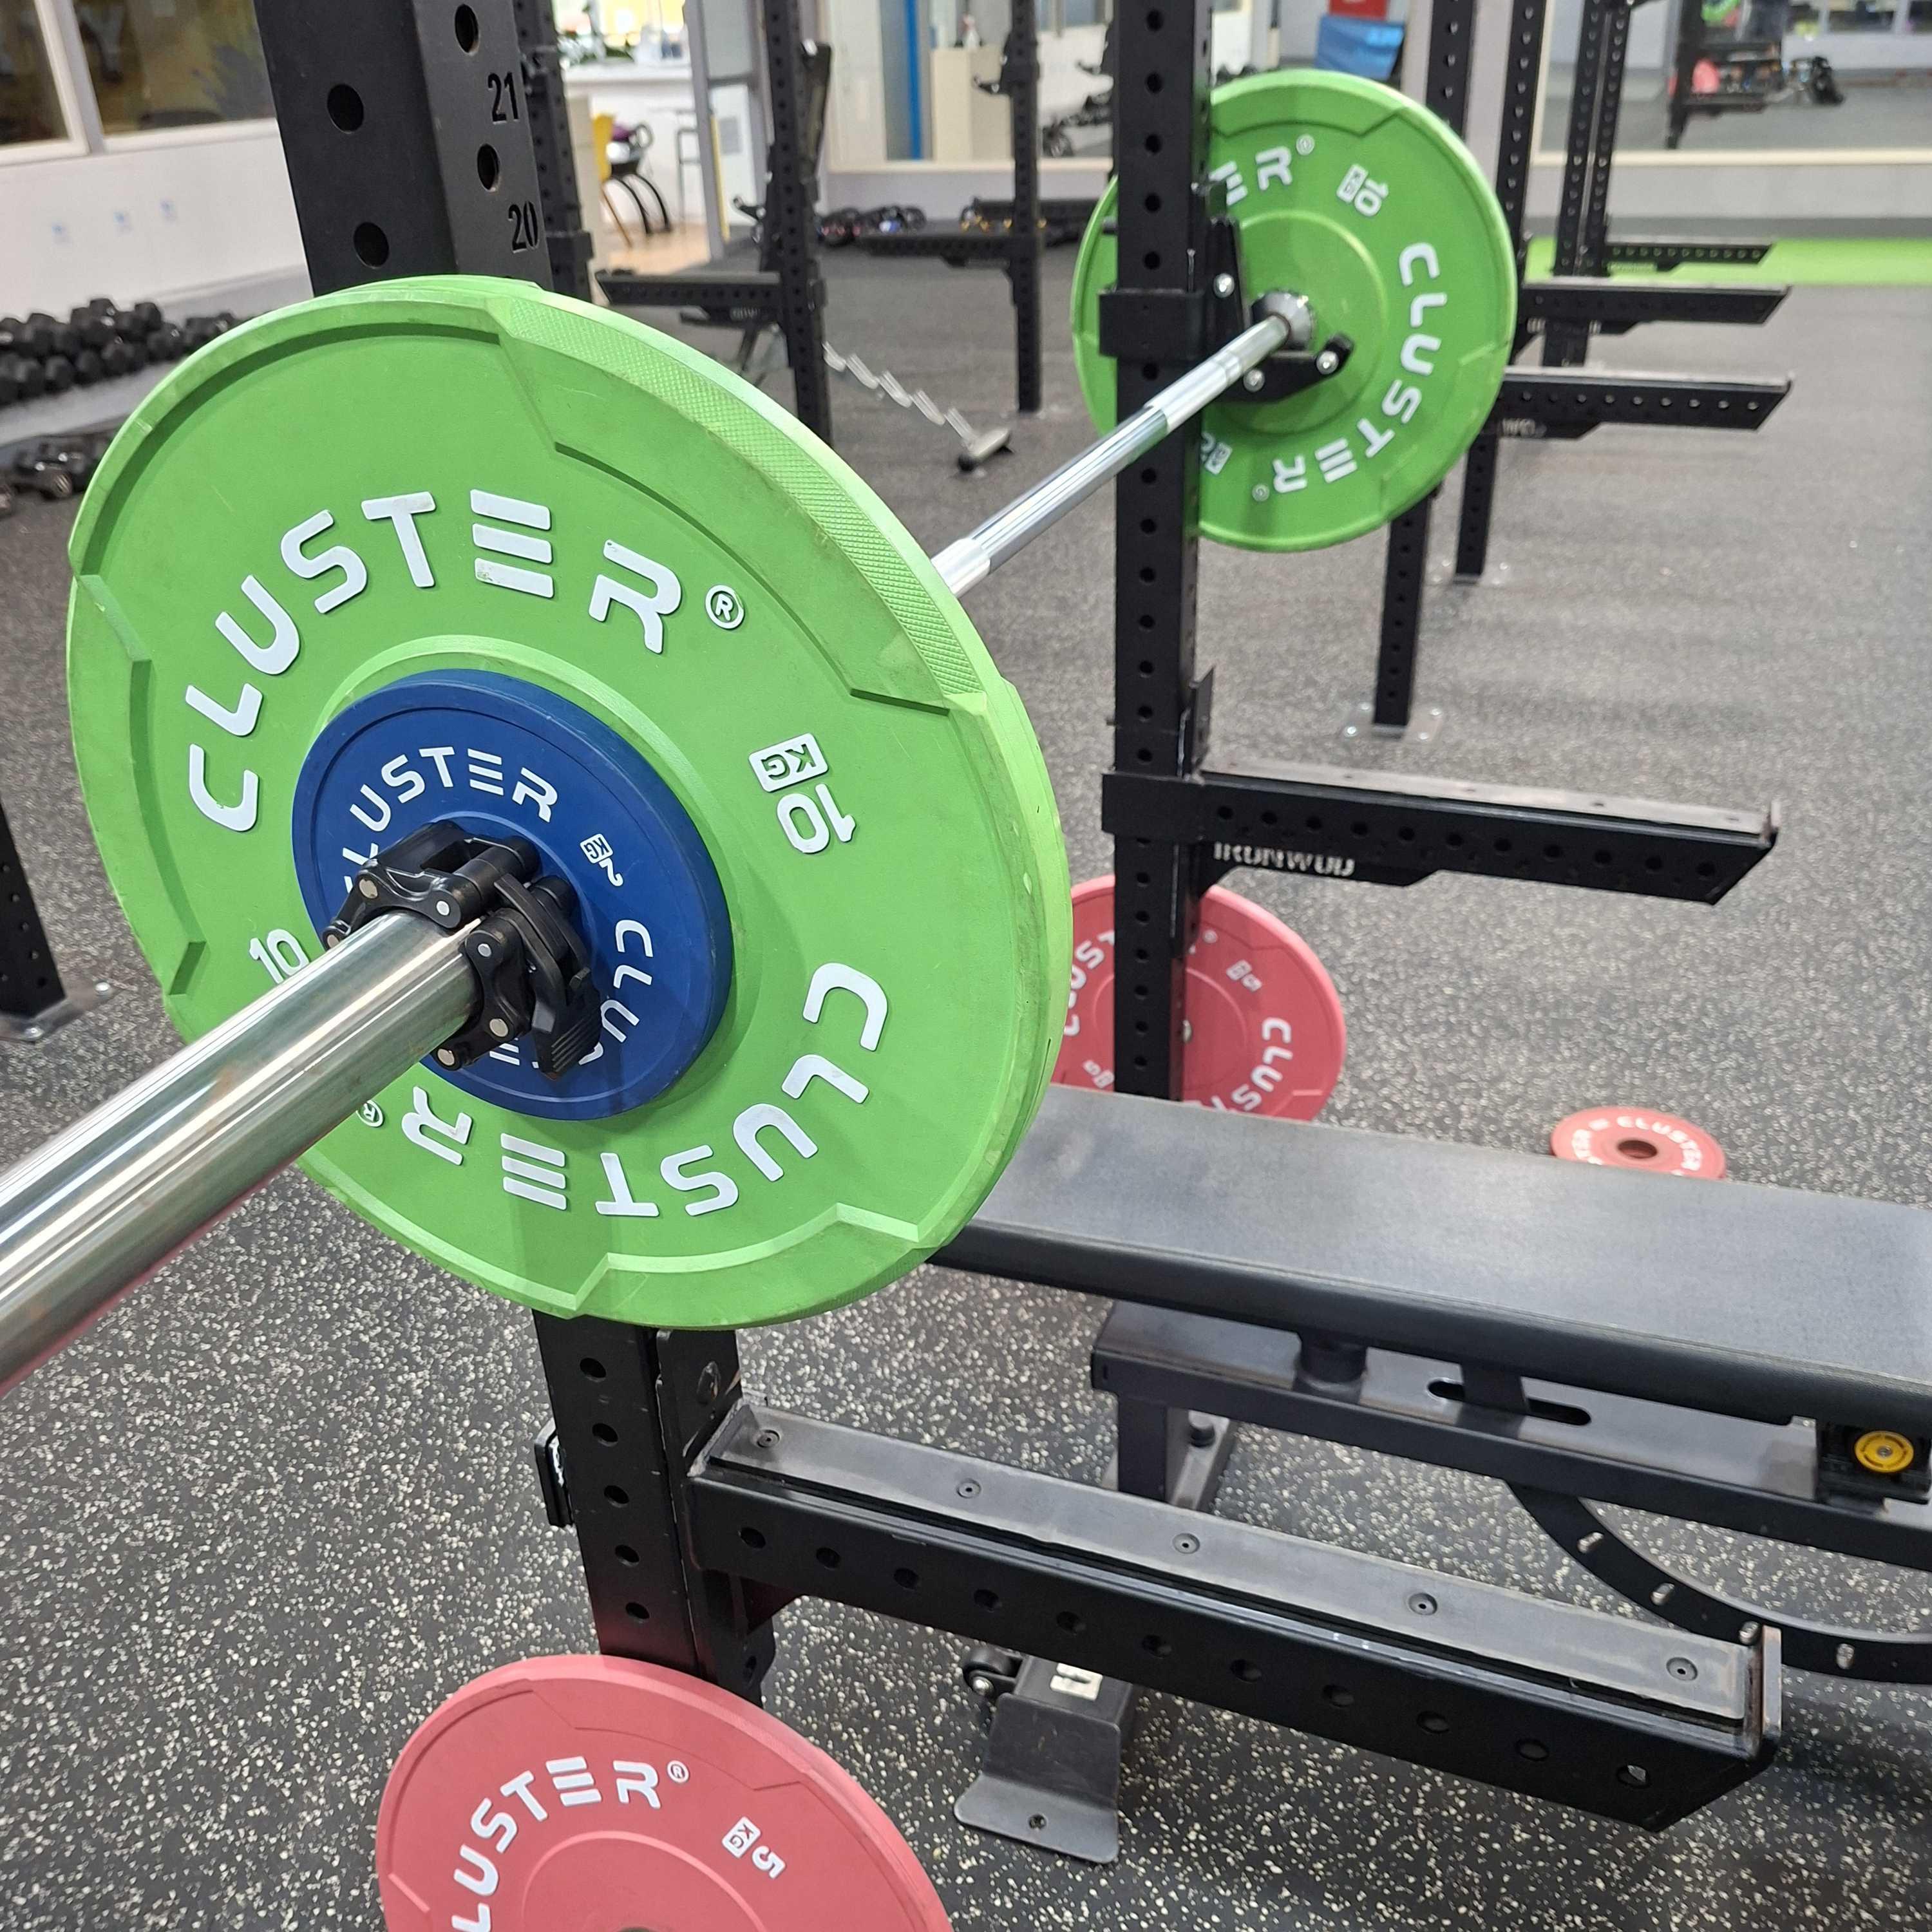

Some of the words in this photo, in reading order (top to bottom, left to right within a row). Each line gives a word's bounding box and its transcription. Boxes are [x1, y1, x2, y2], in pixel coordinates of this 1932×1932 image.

[488, 71, 518, 122] 21
[1354, 178, 1389, 217] 10
[507, 200, 538, 252] 20
[757, 741, 819, 784] KG
[342, 746, 559, 894] LUSTER
[776, 782, 857, 855] 10
[582, 835, 611, 860] KG
[598, 857, 624, 887] 2
[249, 928, 310, 985] 10
[726, 1821, 757, 1852] KG
[752, 1845, 786, 1879] 5
